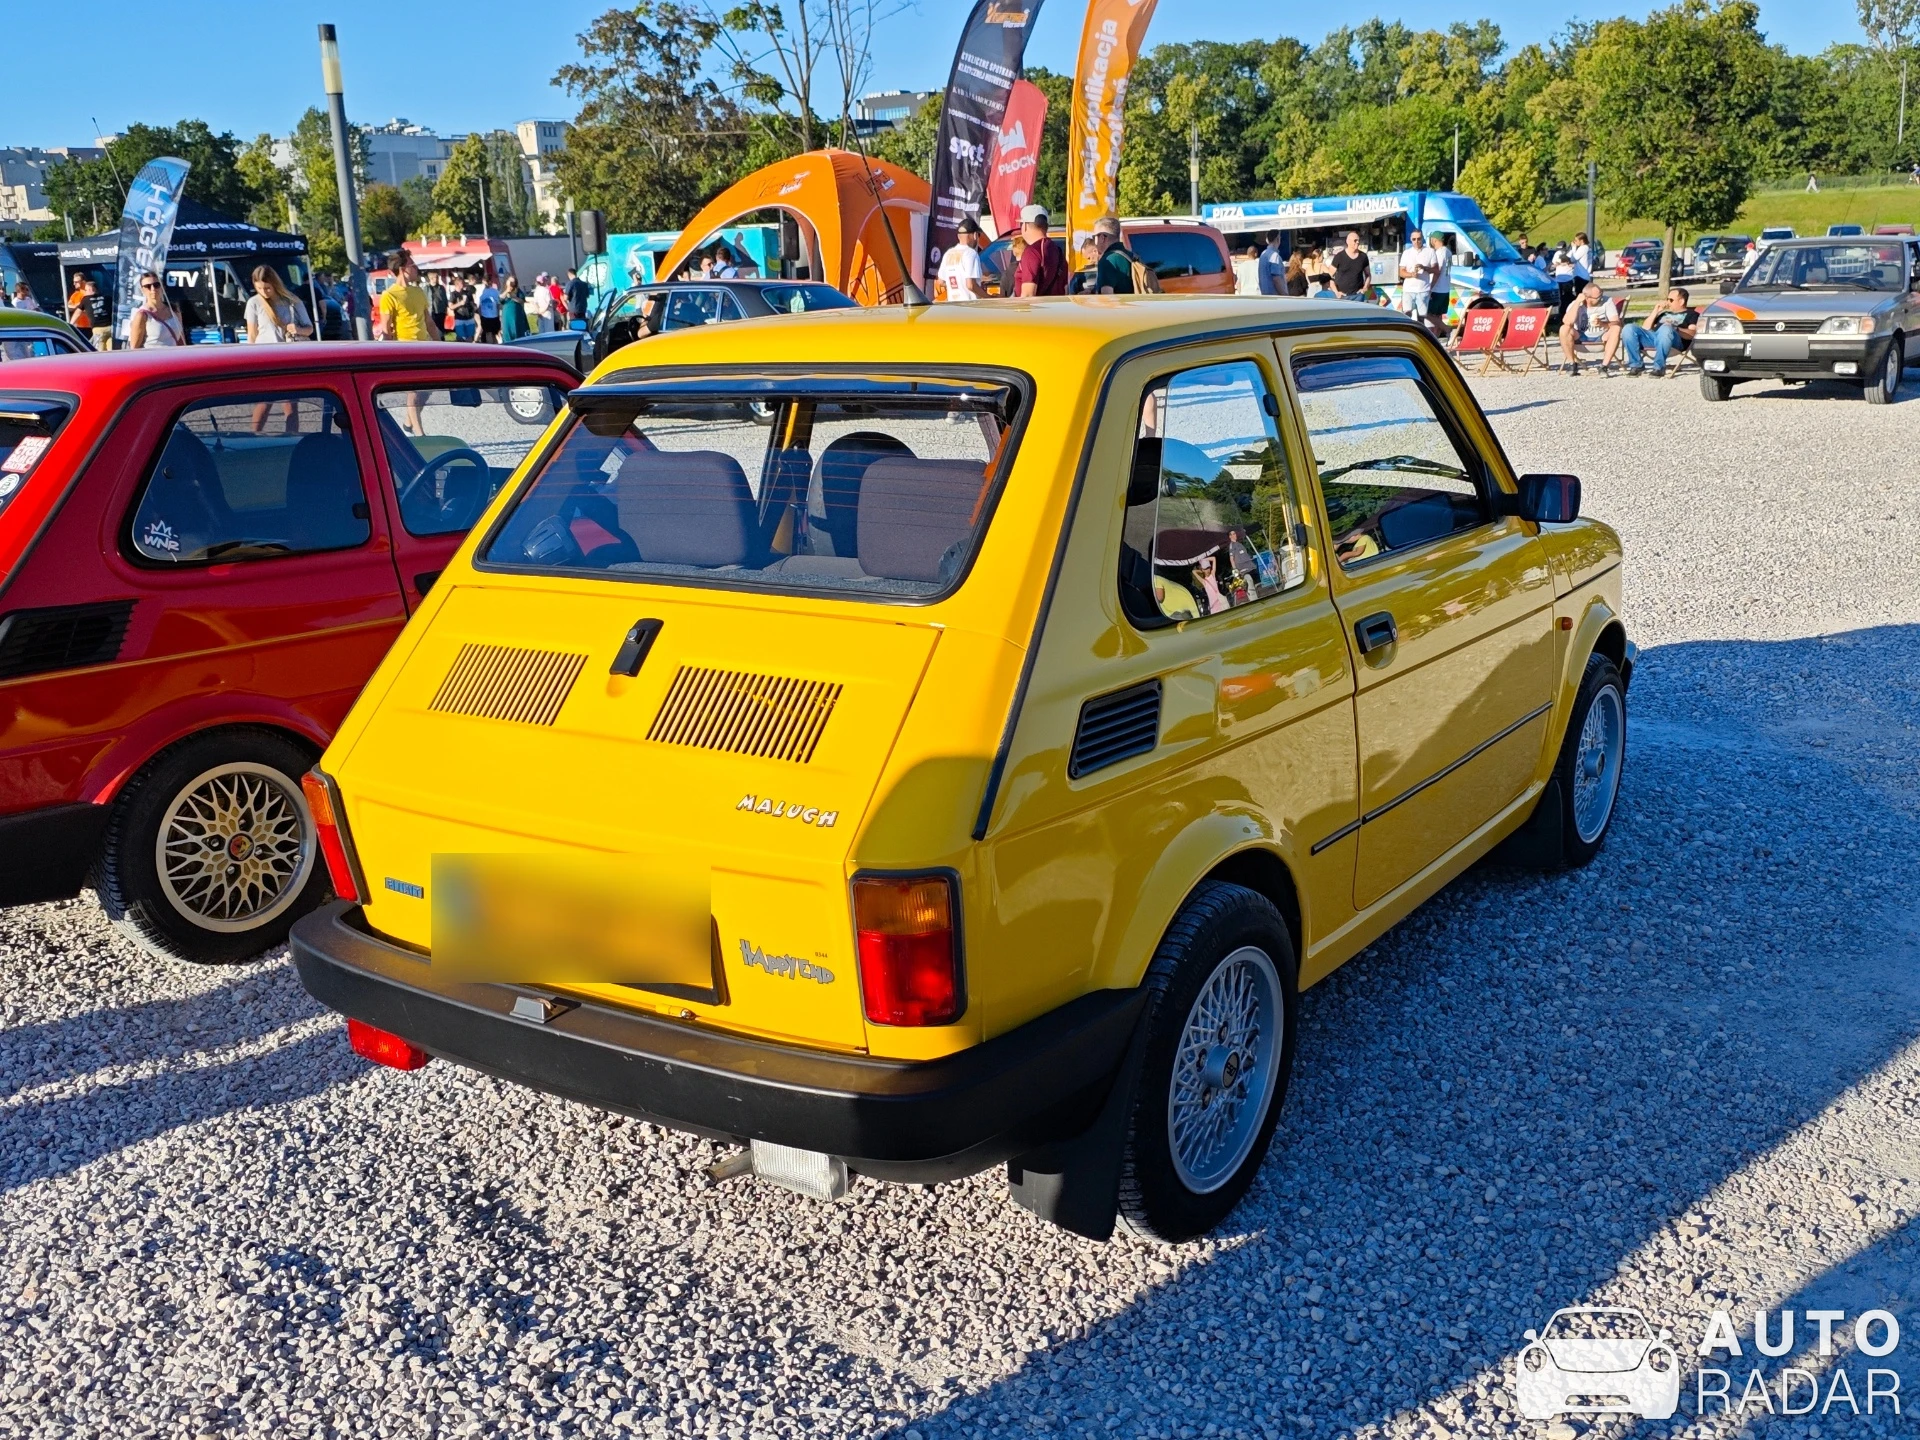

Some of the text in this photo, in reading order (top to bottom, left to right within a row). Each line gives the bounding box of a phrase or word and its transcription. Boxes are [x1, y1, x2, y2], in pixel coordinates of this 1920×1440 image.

[1085, 19, 1118, 132] aplikacja
[998, 154, 1036, 176] PŁOCK
[1212, 196, 1400, 219] PIZZA CAFFE LIMONATA
[166, 271, 199, 287] GTV
[1472, 324, 1491, 332] cafe
[1473, 316, 1493, 325] stop
[1514, 323, 1535, 331] cafe
[1516, 315, 1536, 324] stop
[144, 534, 180, 551] WNR
[736, 794, 840, 828] MALUCH
[739, 938, 836, 985] HAPPY END
